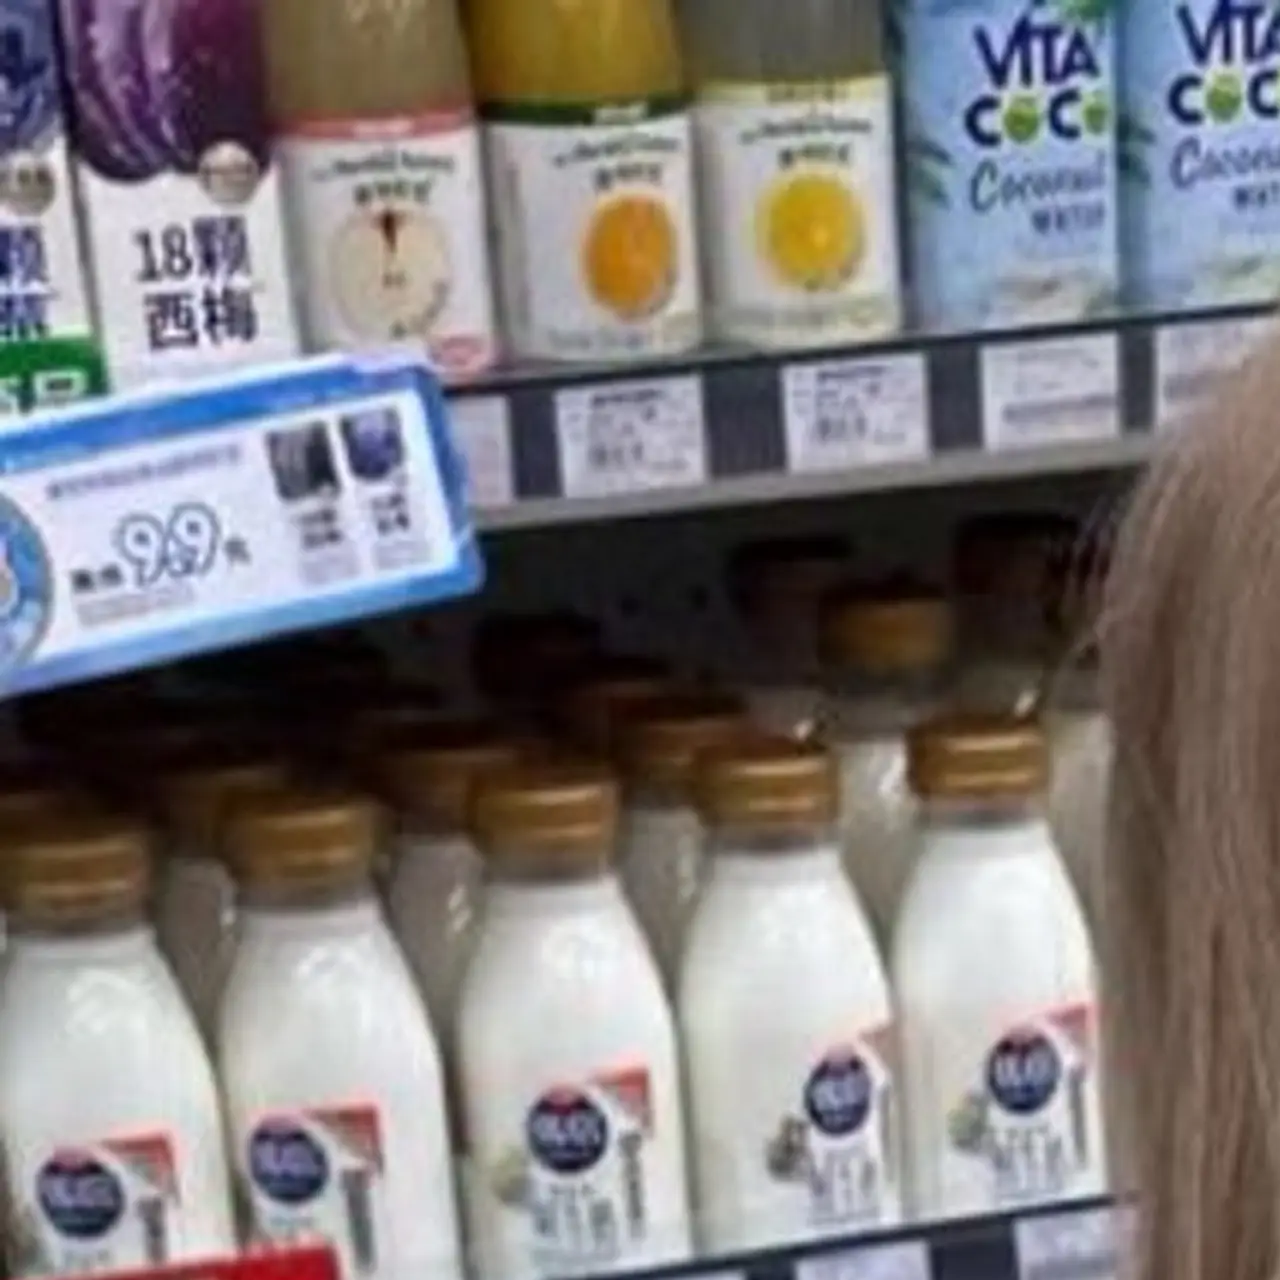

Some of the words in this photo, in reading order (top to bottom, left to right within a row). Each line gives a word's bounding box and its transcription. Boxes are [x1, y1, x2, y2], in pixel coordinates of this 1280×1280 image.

[973, 14, 1100, 87] VITA
[964, 87, 1107, 146] COCO
[133, 214, 250, 282] 18颗
[144, 288, 258, 350] 西梅
